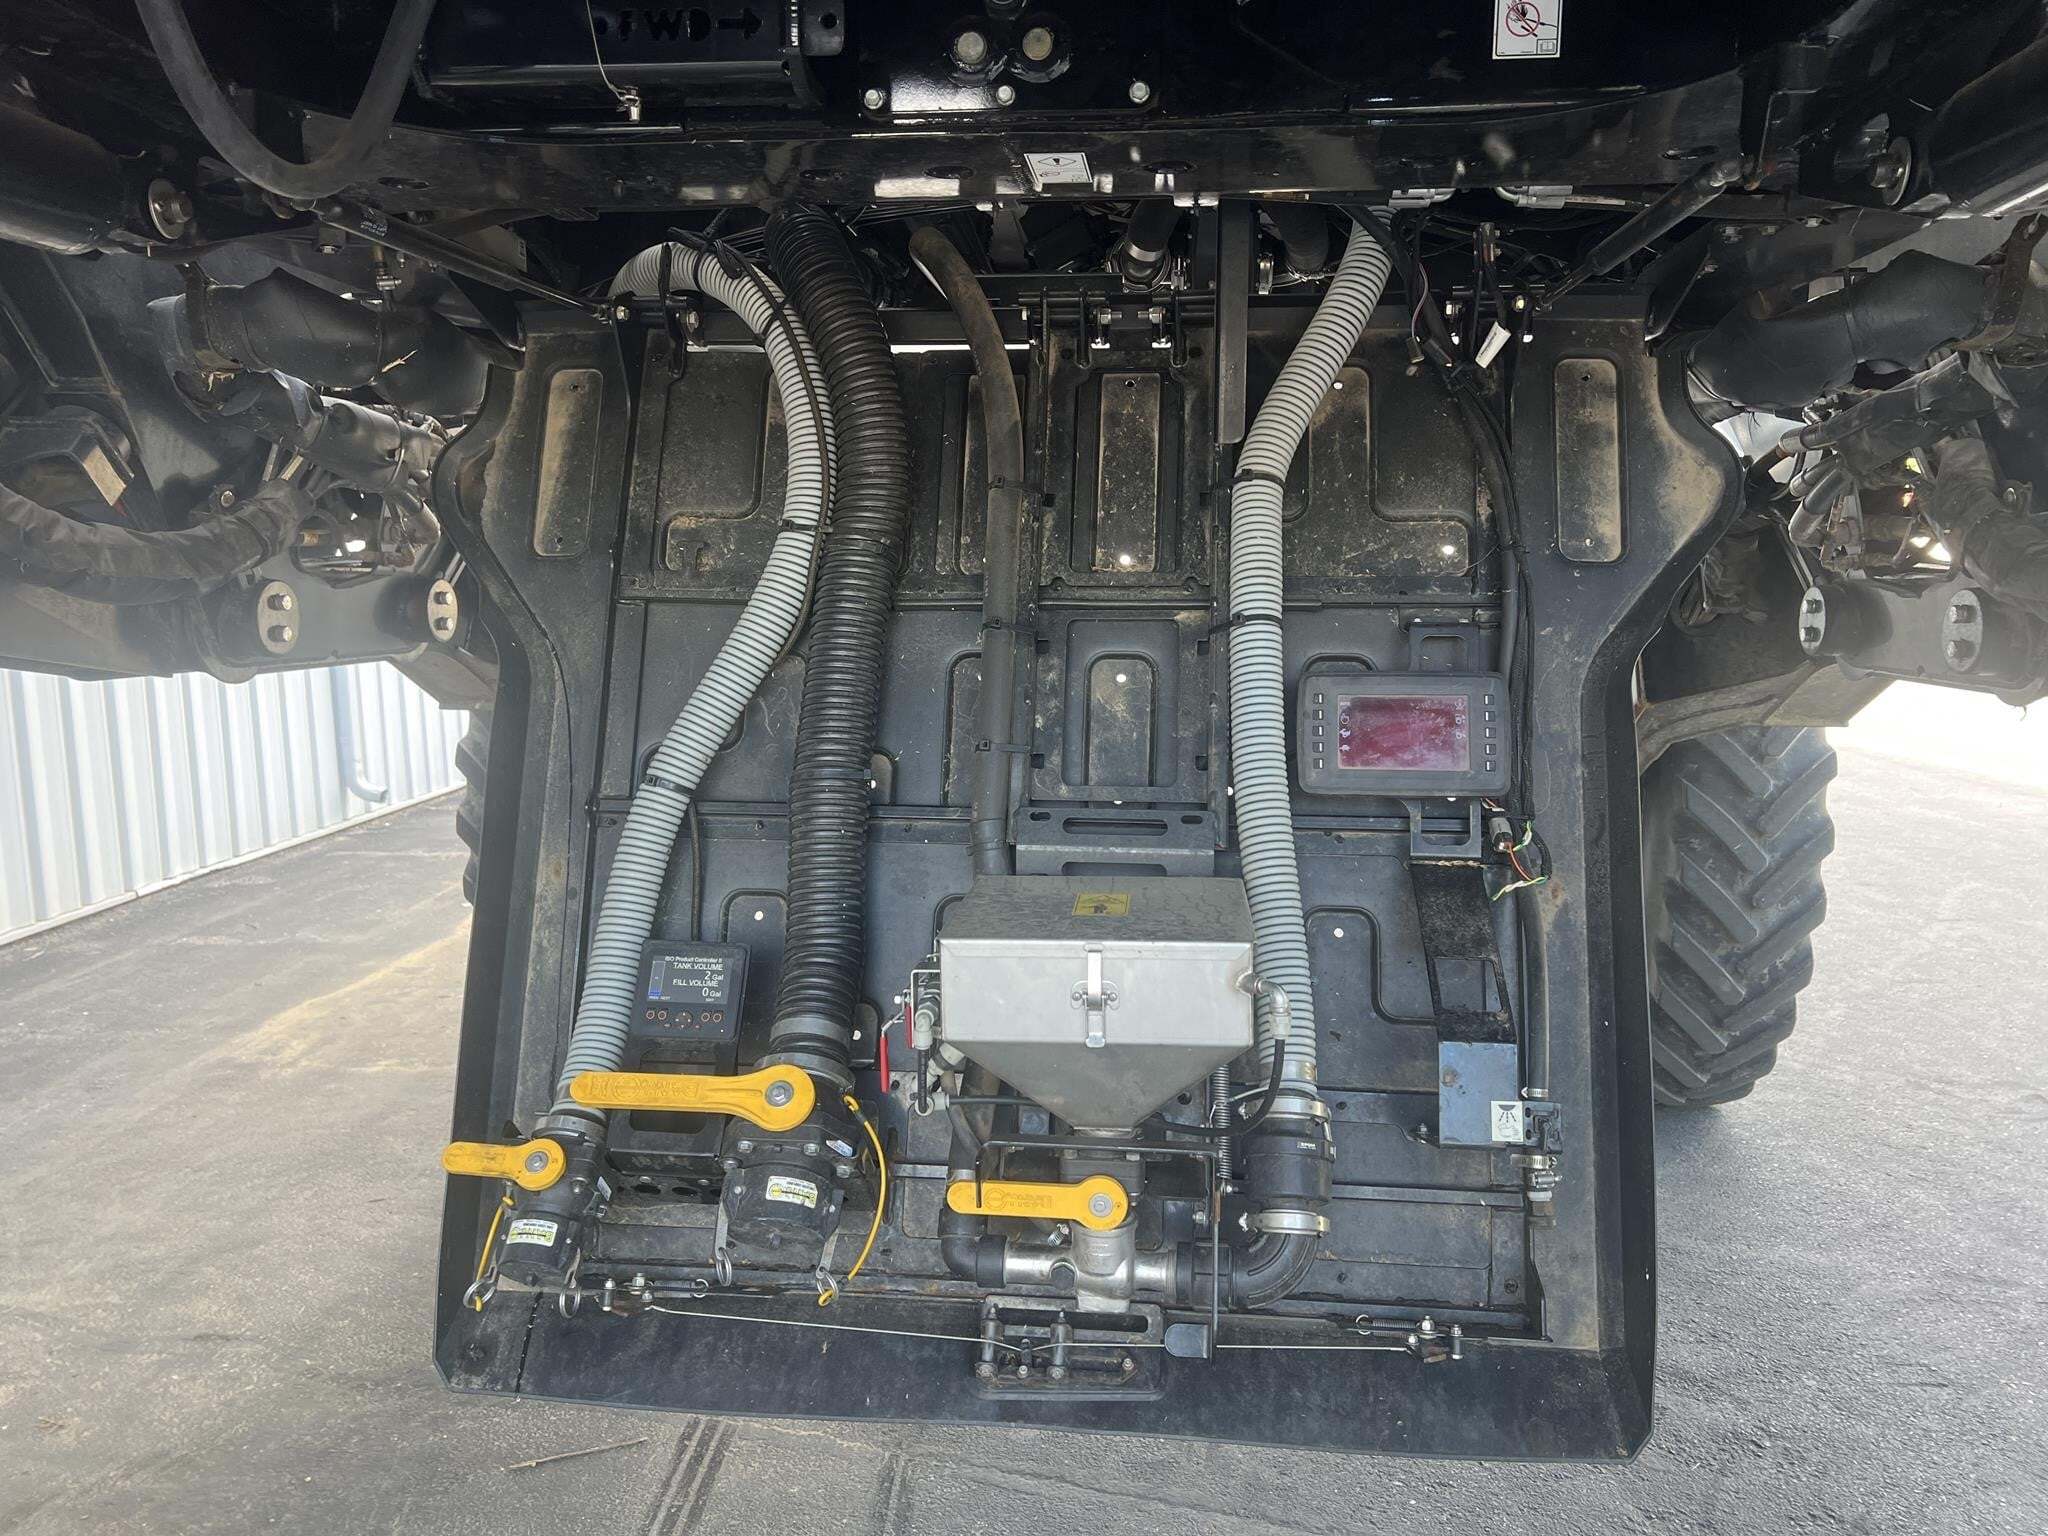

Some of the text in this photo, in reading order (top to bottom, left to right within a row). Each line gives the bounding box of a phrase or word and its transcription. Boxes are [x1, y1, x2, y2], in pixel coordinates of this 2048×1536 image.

[616, 9, 712, 42] FWD
[704, 970, 711, 980] 2
[689, 979, 719, 987] VOLUME
[702, 987, 709, 997] 0
